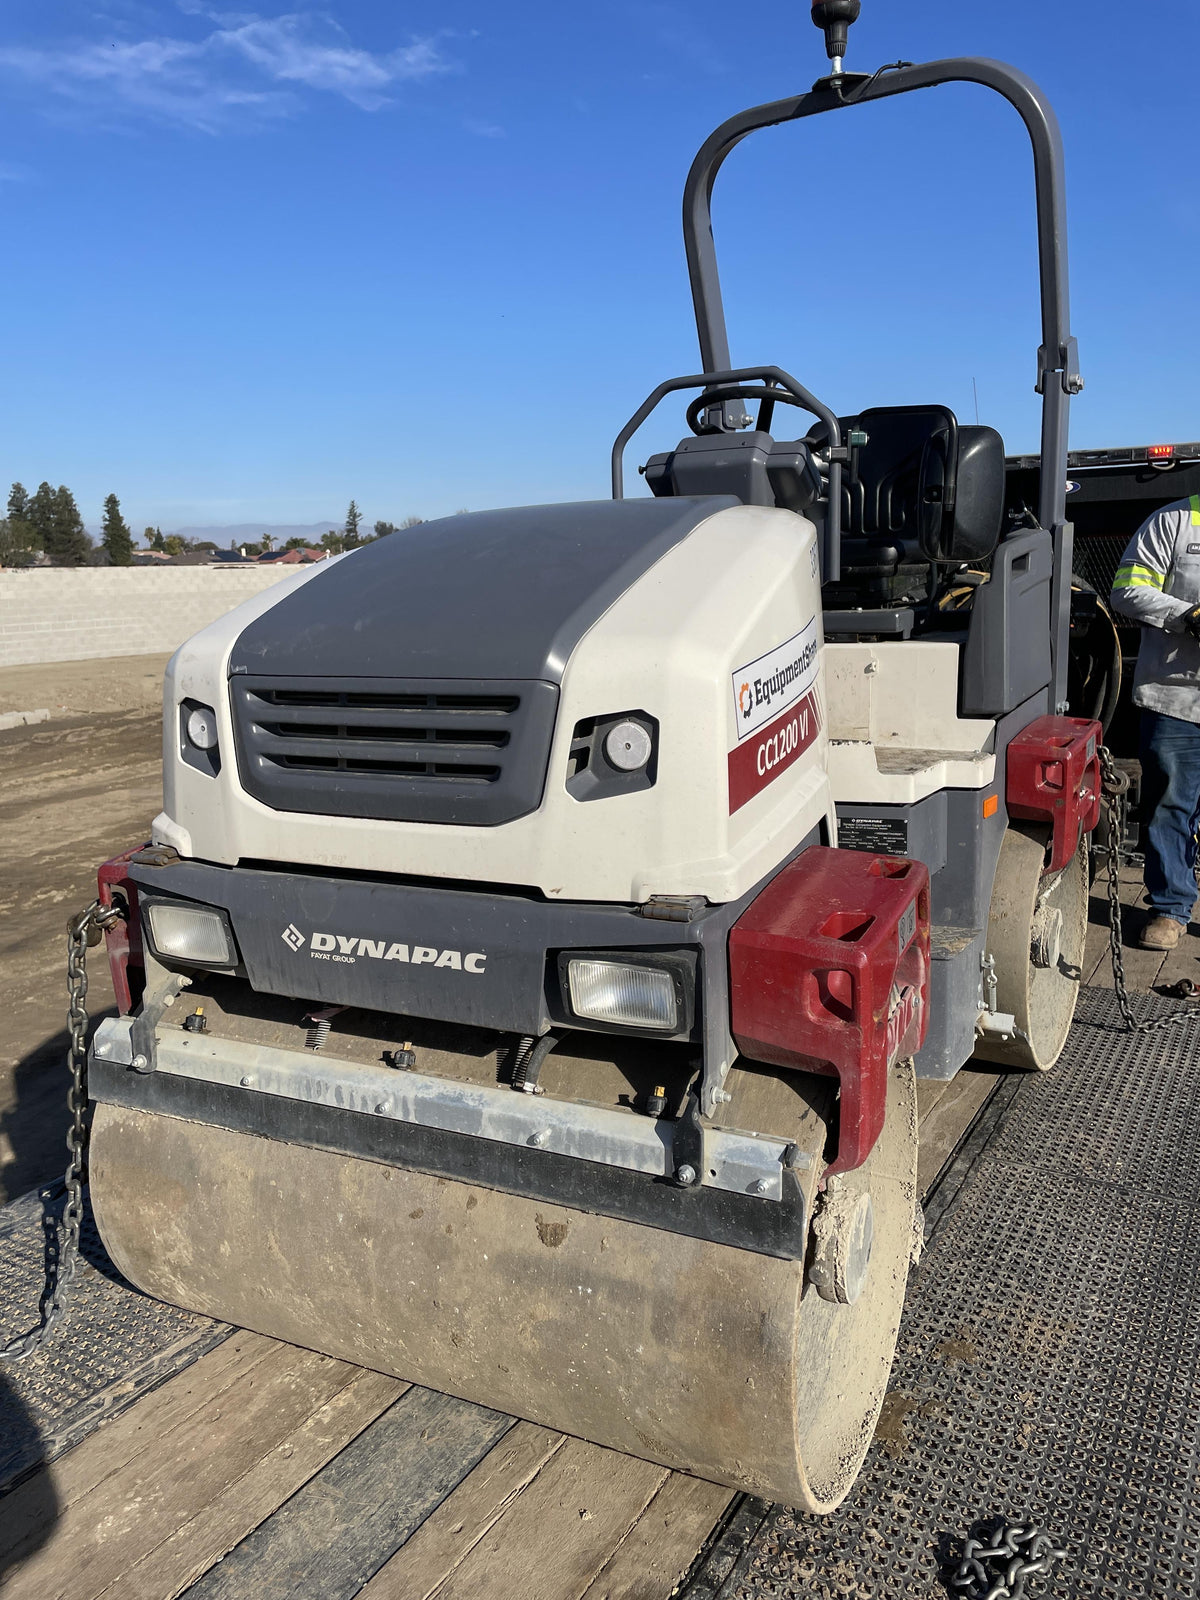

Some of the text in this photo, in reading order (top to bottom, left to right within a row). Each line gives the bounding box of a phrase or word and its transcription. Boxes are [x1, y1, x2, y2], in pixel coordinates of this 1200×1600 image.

[757, 708, 809, 776] CC1200 VI
[310, 932, 487, 974] DYNAPAC
[310, 952, 356, 964] FAYAT GROUP
